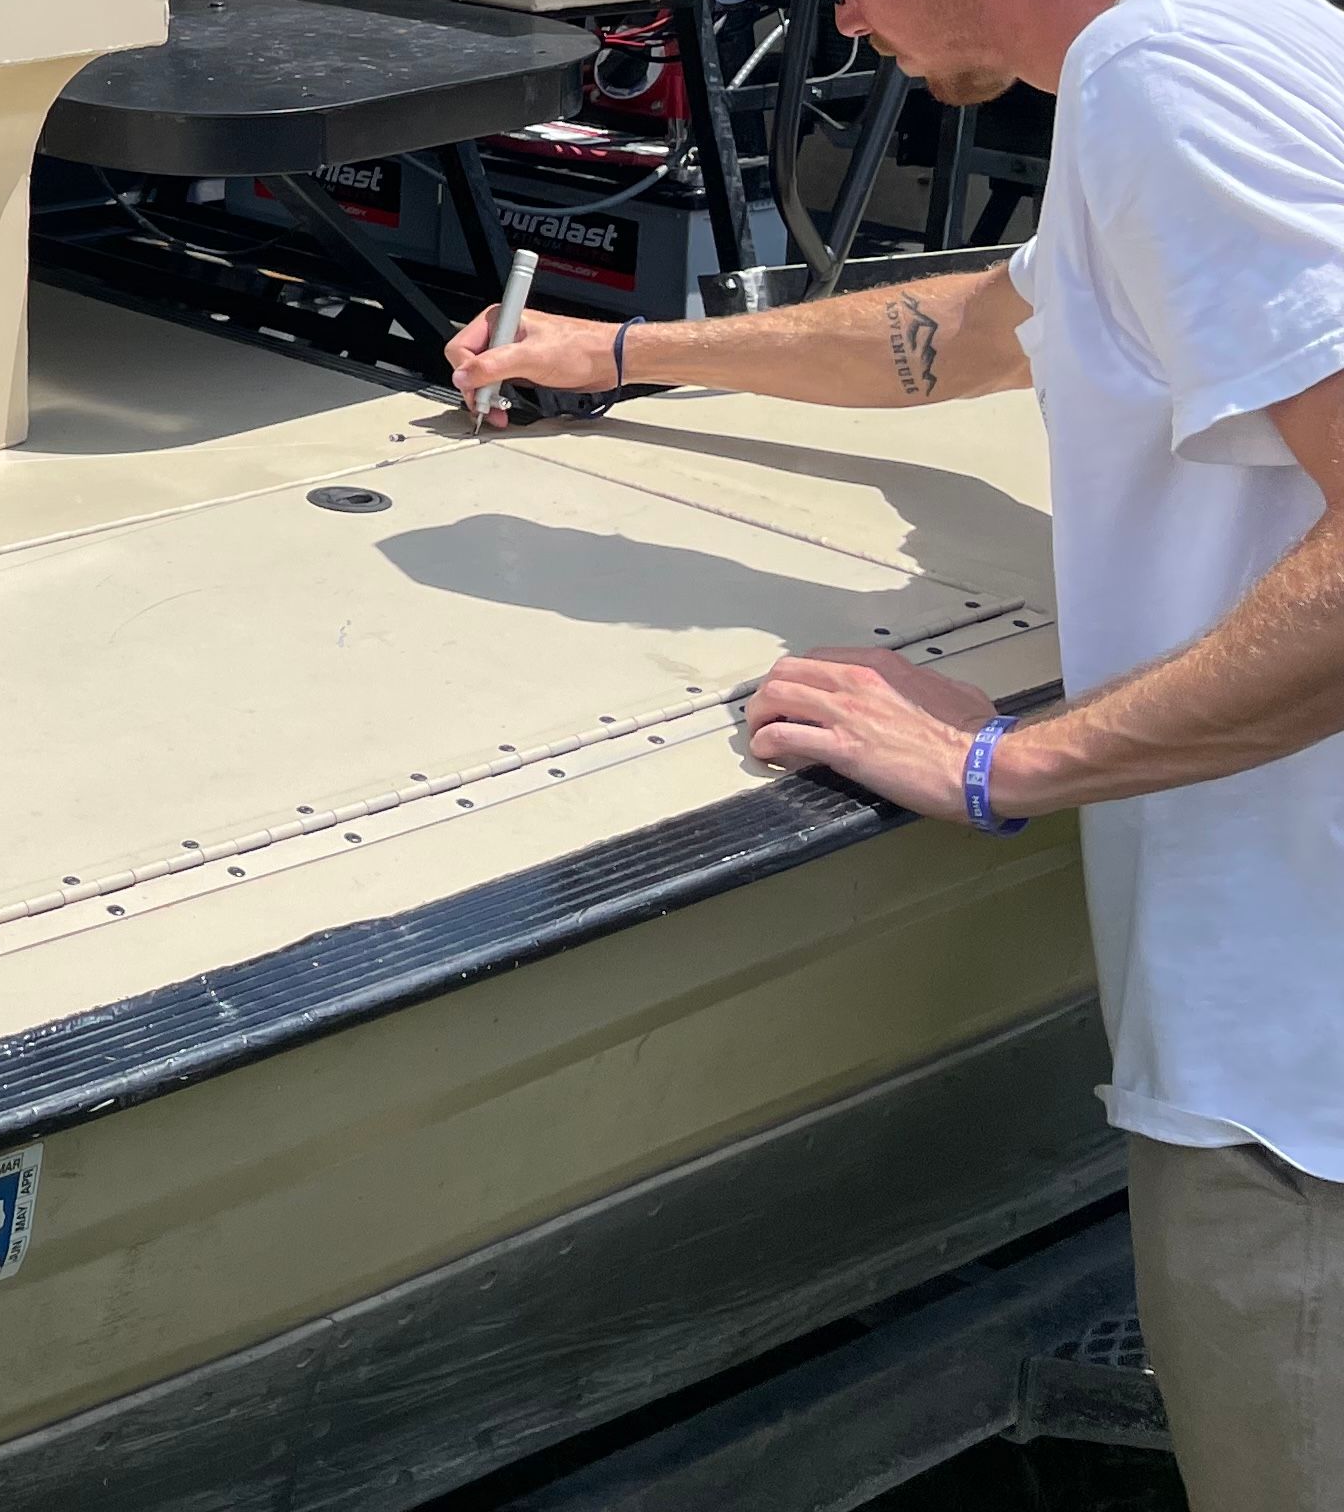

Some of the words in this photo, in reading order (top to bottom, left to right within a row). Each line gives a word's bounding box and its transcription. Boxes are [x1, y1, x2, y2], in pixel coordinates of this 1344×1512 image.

[886, 301, 919, 394] ADVENTURE
[21, 1168, 34, 1195] APR
[15, 1206, 27, 1232] MAY
[9, 1239, 23, 1263] JUN
